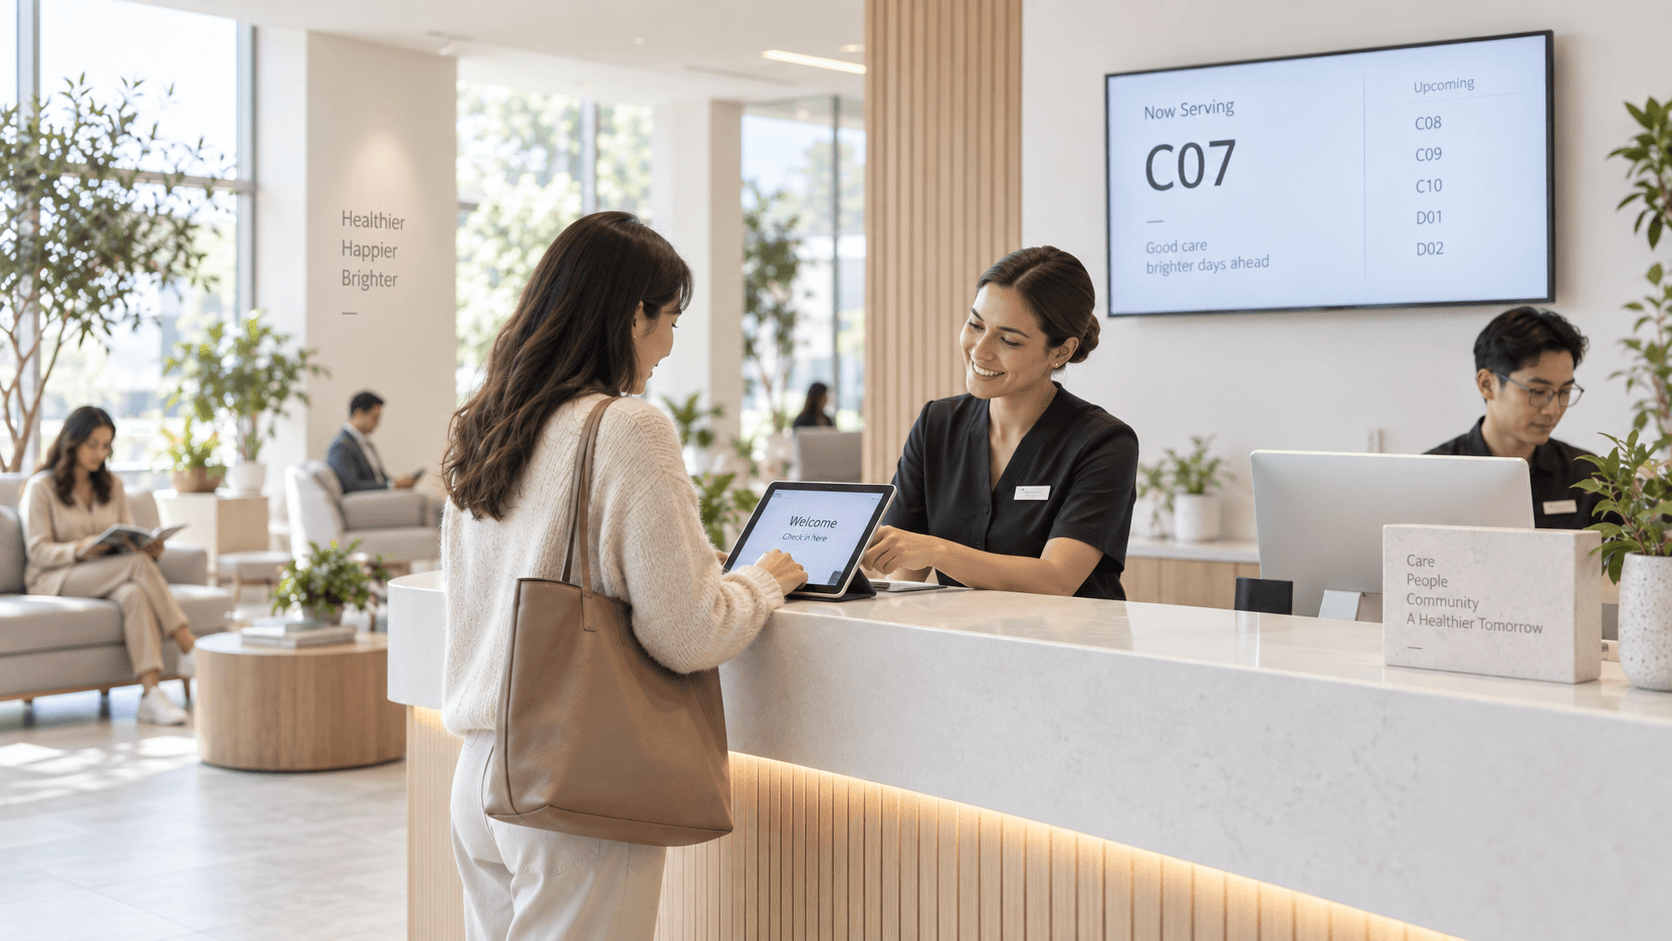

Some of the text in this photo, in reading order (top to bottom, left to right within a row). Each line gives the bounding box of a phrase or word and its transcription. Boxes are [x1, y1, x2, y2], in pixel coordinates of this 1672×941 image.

[1414, 77, 1474, 94] Upcoming
[1144, 99, 1234, 119] Now Serving
[1415, 116, 1441, 130] C08
[1415, 147, 1442, 161] C09
[1145, 139, 1236, 191] C07
[1415, 178, 1442, 193] C10
[342, 209, 405, 230] Healthier
[1416, 210, 1441, 224] D01
[342, 239, 398, 262] Happier
[1146, 240, 1207, 254] Good care
[1416, 241, 1444, 256] D02
[1147, 254, 1269, 277] brighter days ahead
[342, 269, 398, 291] Brighter
[790, 516, 837, 528] Welcome
[782, 532, 828, 543] Check in here
[1407, 554, 1435, 567] Care
[1407, 573, 1448, 589] People
[1407, 593, 1479, 612] Community
[1406, 612, 1543, 634] A Healthier Tomorrow
